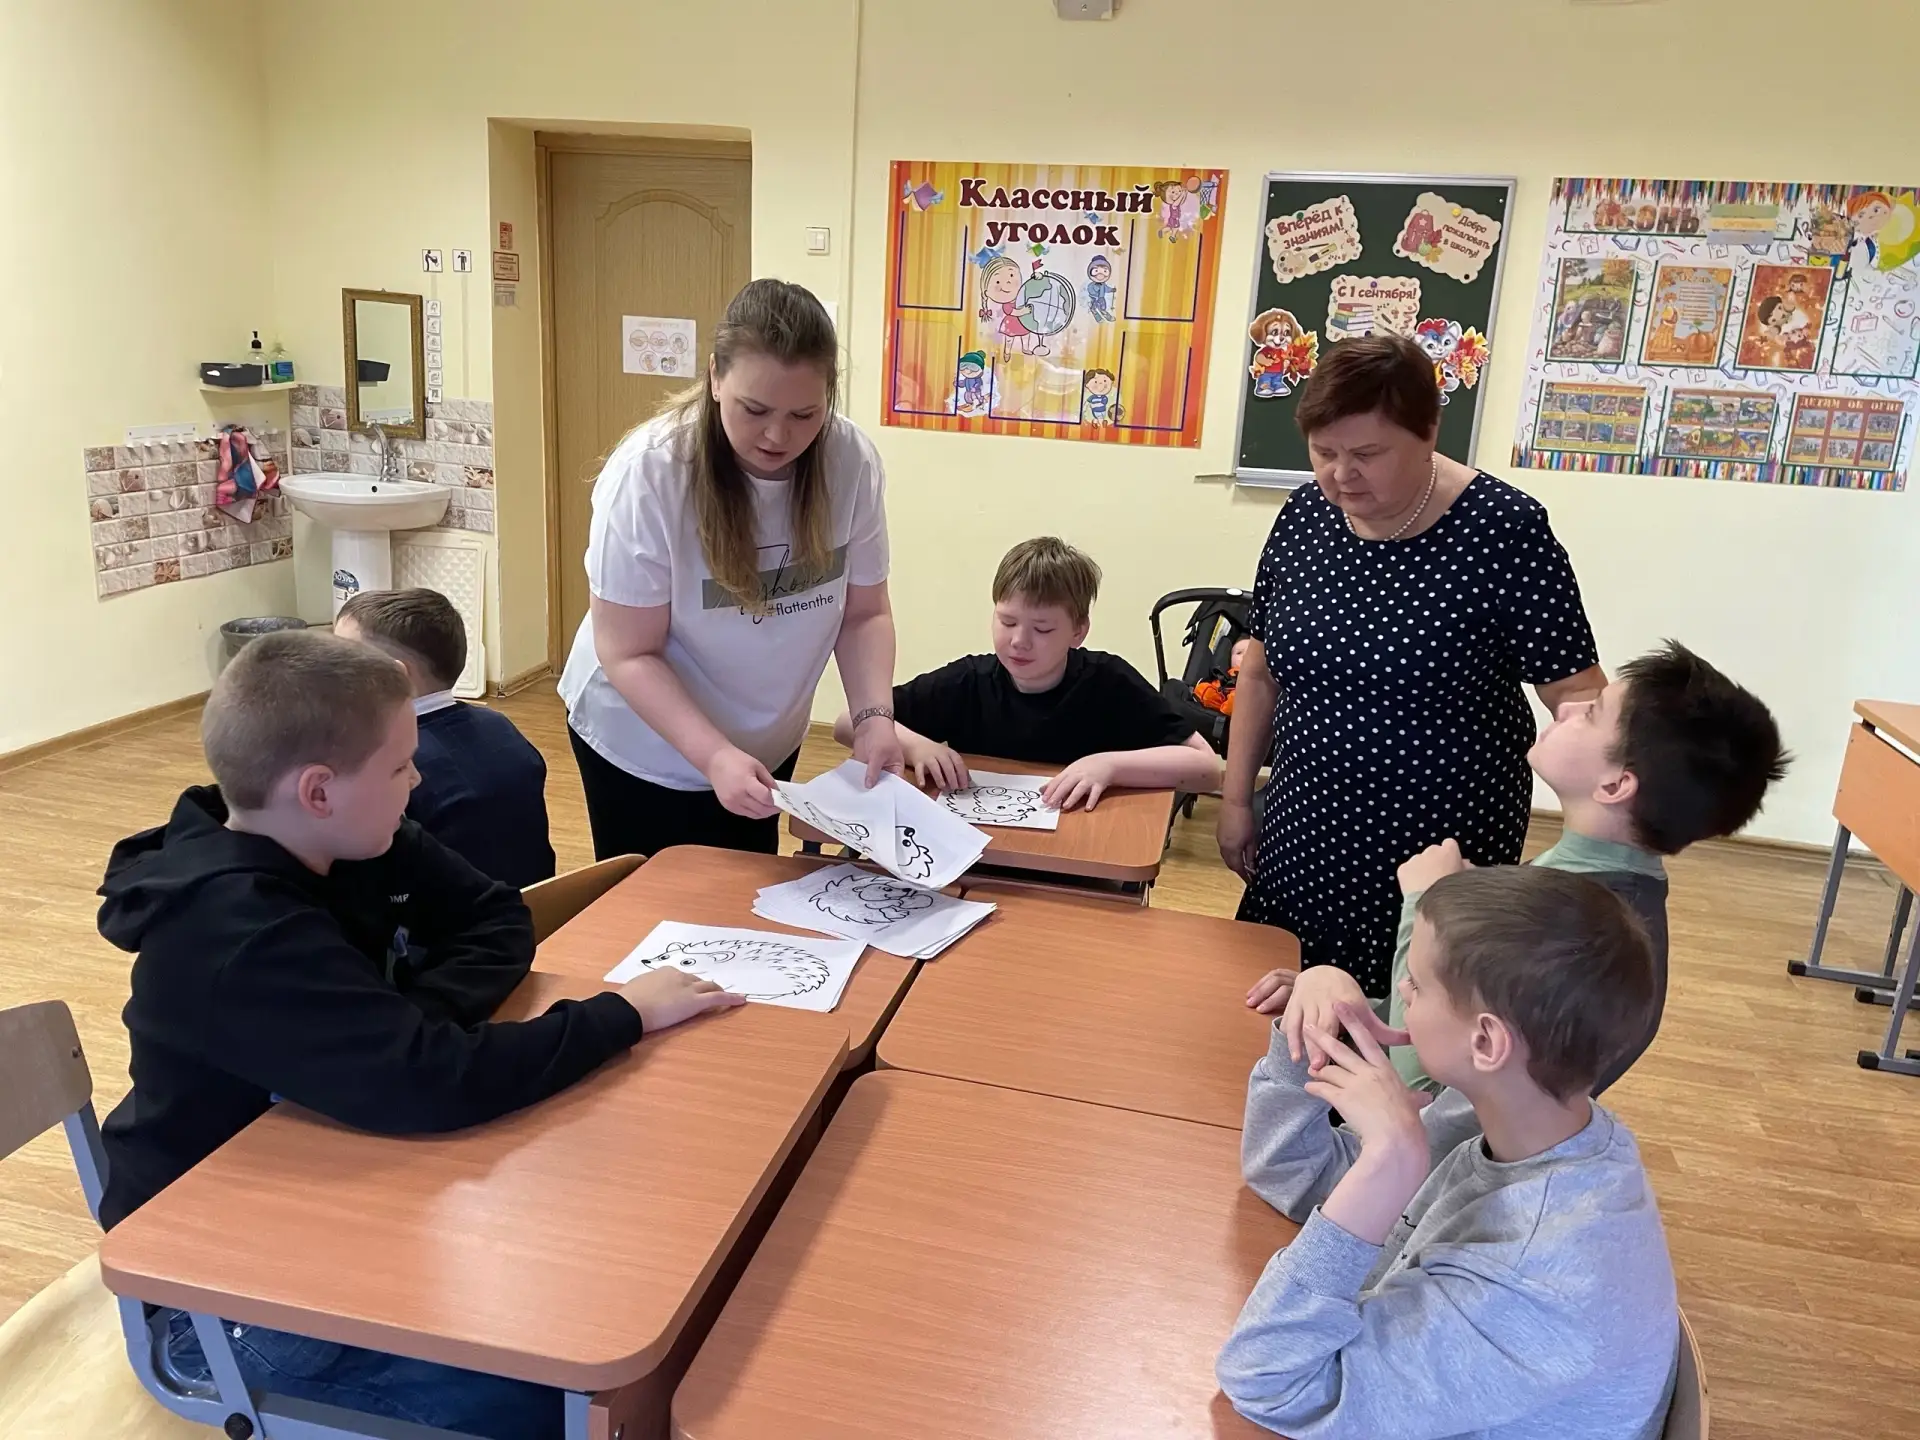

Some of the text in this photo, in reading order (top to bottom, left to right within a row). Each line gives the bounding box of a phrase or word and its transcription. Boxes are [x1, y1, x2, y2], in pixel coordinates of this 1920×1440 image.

[959, 179, 1154, 213] Классный
[985, 221, 1120, 247] уголок
[1276, 210, 1332, 236] Вперёд
[1283, 218, 1344, 249] знаниям!
[1458, 215, 1487, 233] Добро
[1442, 224, 1490, 250] пожаловать
[1450, 241, 1480, 258] школу!
[1337, 286, 1417, 302] С 1 сентября!
